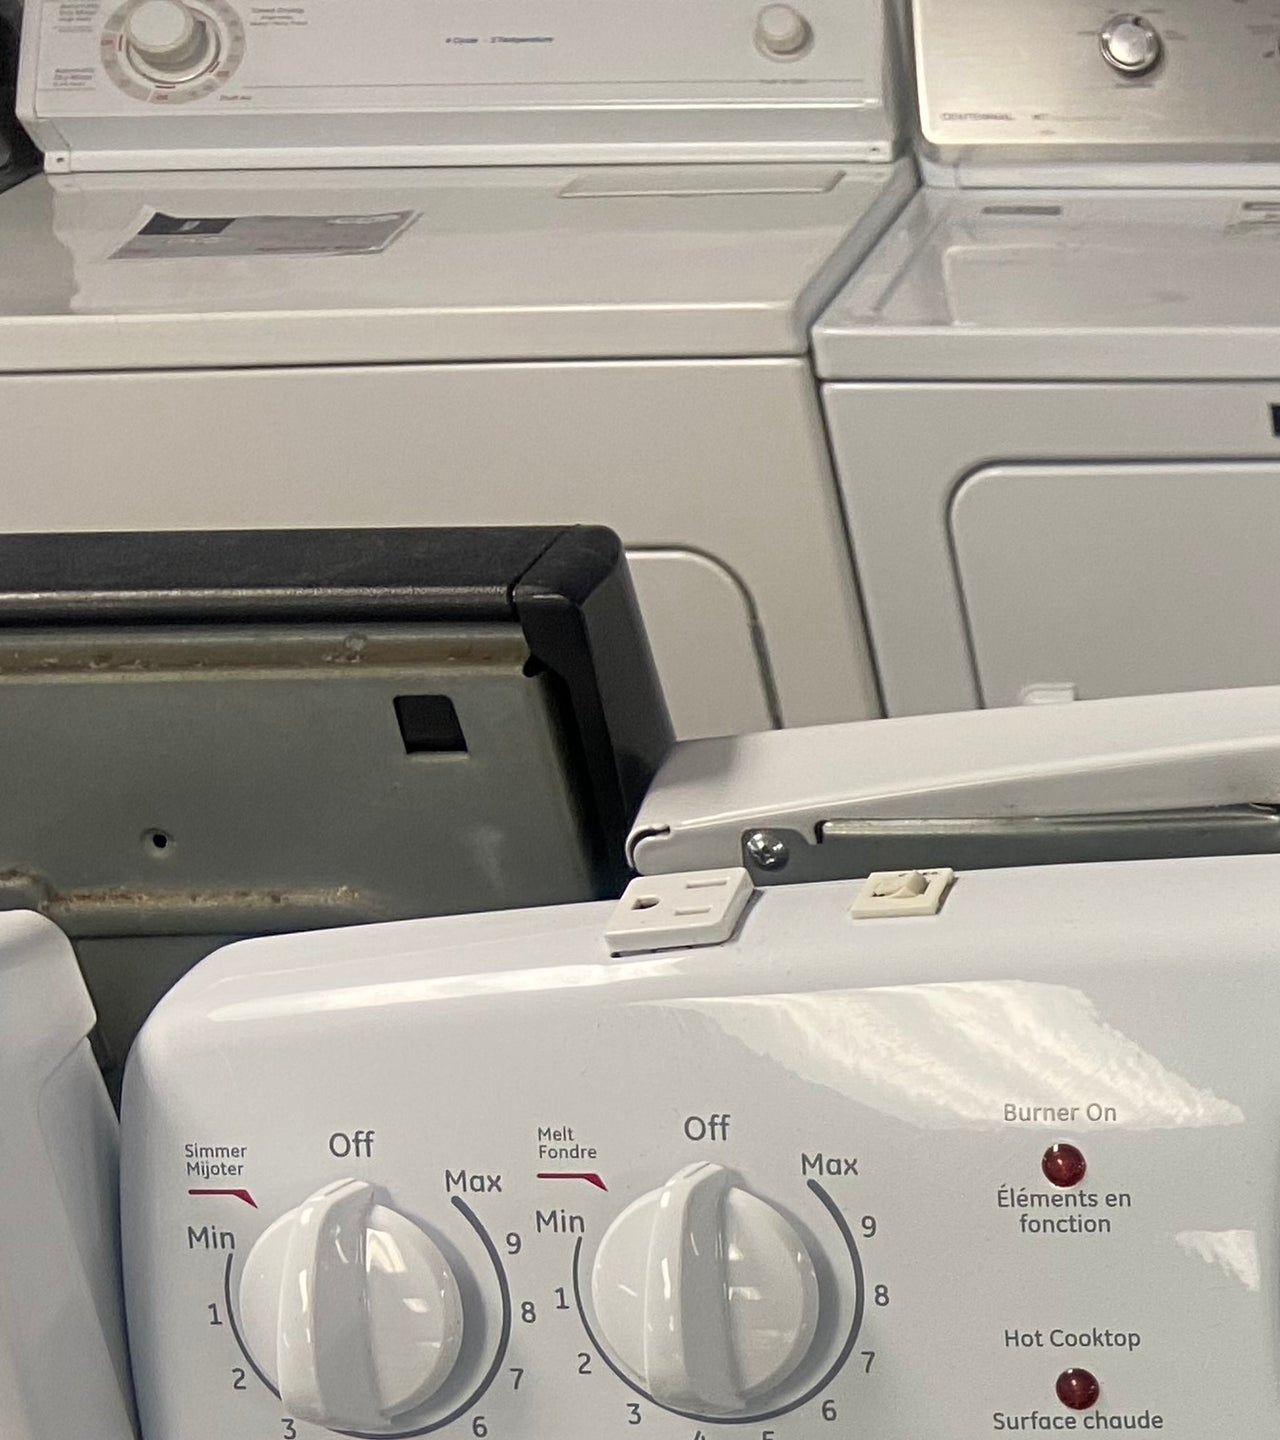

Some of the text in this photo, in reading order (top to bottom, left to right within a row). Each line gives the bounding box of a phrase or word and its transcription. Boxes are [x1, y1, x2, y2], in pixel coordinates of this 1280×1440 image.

[1004, 1102, 1117, 1122] Burner On
[537, 1125, 575, 1142] Melt
[684, 1113, 731, 1142] Off
[184, 1142, 248, 1159] Simmer
[328, 1130, 376, 1158] Off
[538, 1143, 597, 1160] Fondre
[186, 1161, 244, 1180] Mijoter
[801, 1152, 859, 1176] Max
[445, 1169, 503, 1193] Max
[997, 1182, 1132, 1208] Éléments en
[535, 1208, 585, 1234] Min
[861, 1215, 877, 1239] 9
[1019, 1213, 1111, 1234] fonction
[187, 1224, 236, 1250] Min
[505, 1232, 522, 1255] 9
[554, 1286, 570, 1310] 1
[874, 1284, 890, 1307] 8
[207, 1302, 223, 1326] 1
[520, 1301, 537, 1324] 8
[1004, 1327, 1141, 1352] Hot Cooktop
[577, 1352, 592, 1375] 2
[860, 1350, 876, 1374] 7
[231, 1367, 247, 1390] 2
[509, 1367, 524, 1391] 7
[626, 1402, 642, 1425] 3
[821, 1399, 838, 1422] 6
[992, 1409, 1164, 1431] Surface chaude
[281, 1418, 297, 1440] 3
[472, 1415, 488, 1438] 6
